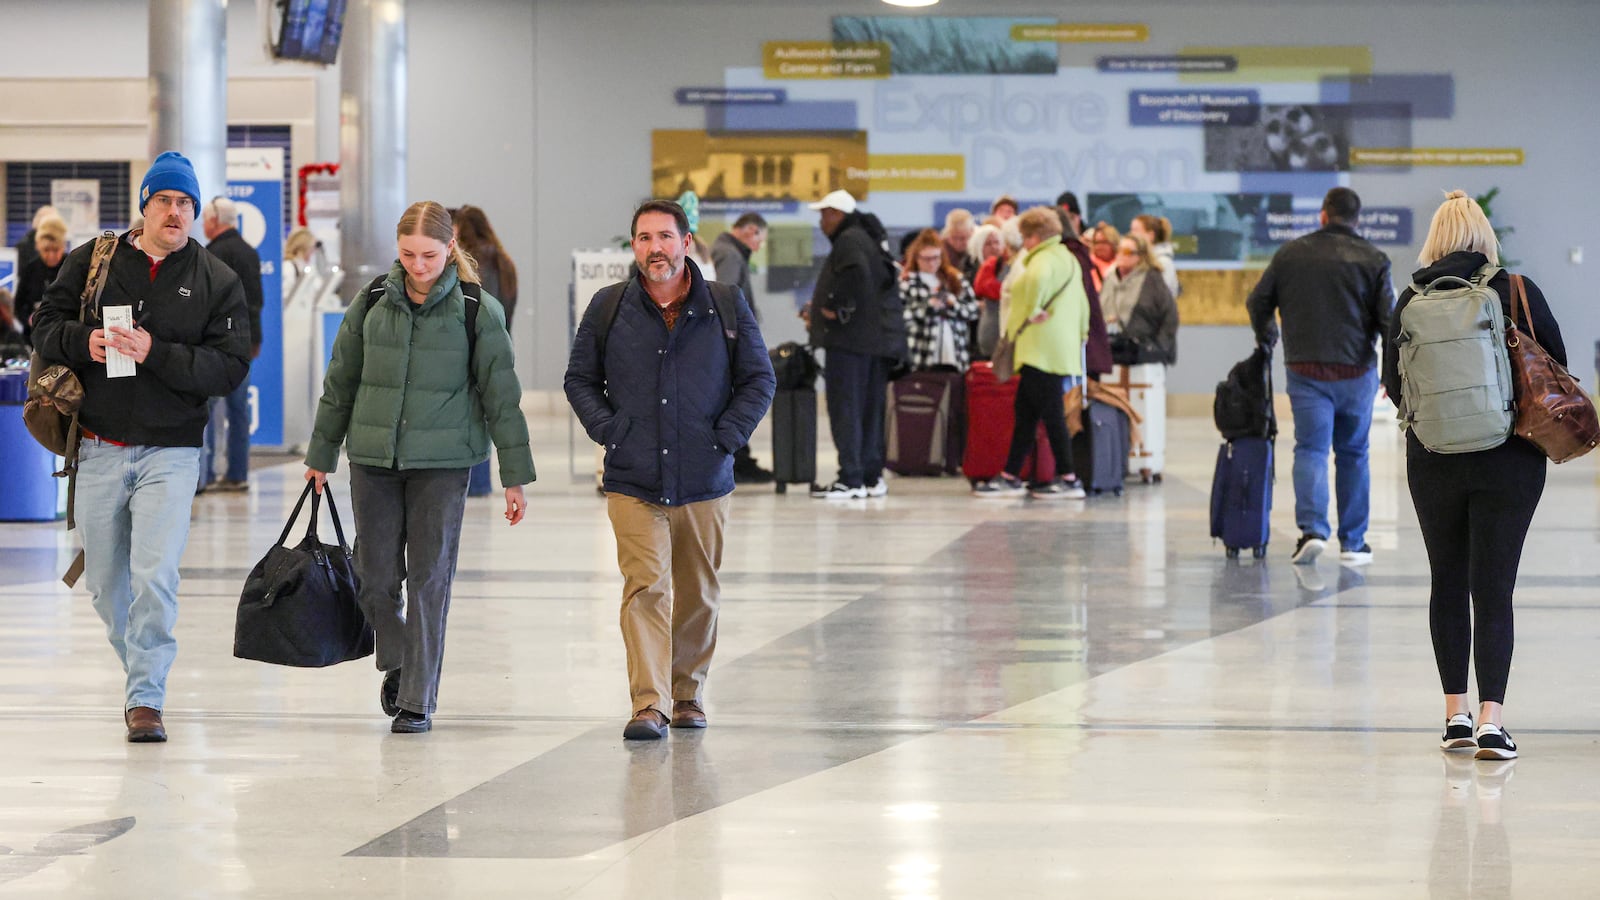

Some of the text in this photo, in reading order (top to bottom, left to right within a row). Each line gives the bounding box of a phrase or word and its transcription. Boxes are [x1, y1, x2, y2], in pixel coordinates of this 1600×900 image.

[779, 63, 876, 74] Center and Farm
[1139, 94, 1249, 106] Boonshoft Museum
[873, 79, 1108, 146] Explore
[1158, 110, 1229, 123] of Discovery
[972, 137, 1197, 194] Dayton
[846, 166, 957, 180] Dayton Art Institute
[1266, 213, 1314, 225] National
[1366, 211, 1378, 224] of
[1380, 213, 1399, 225] the
[1363, 228, 1397, 241] Force
